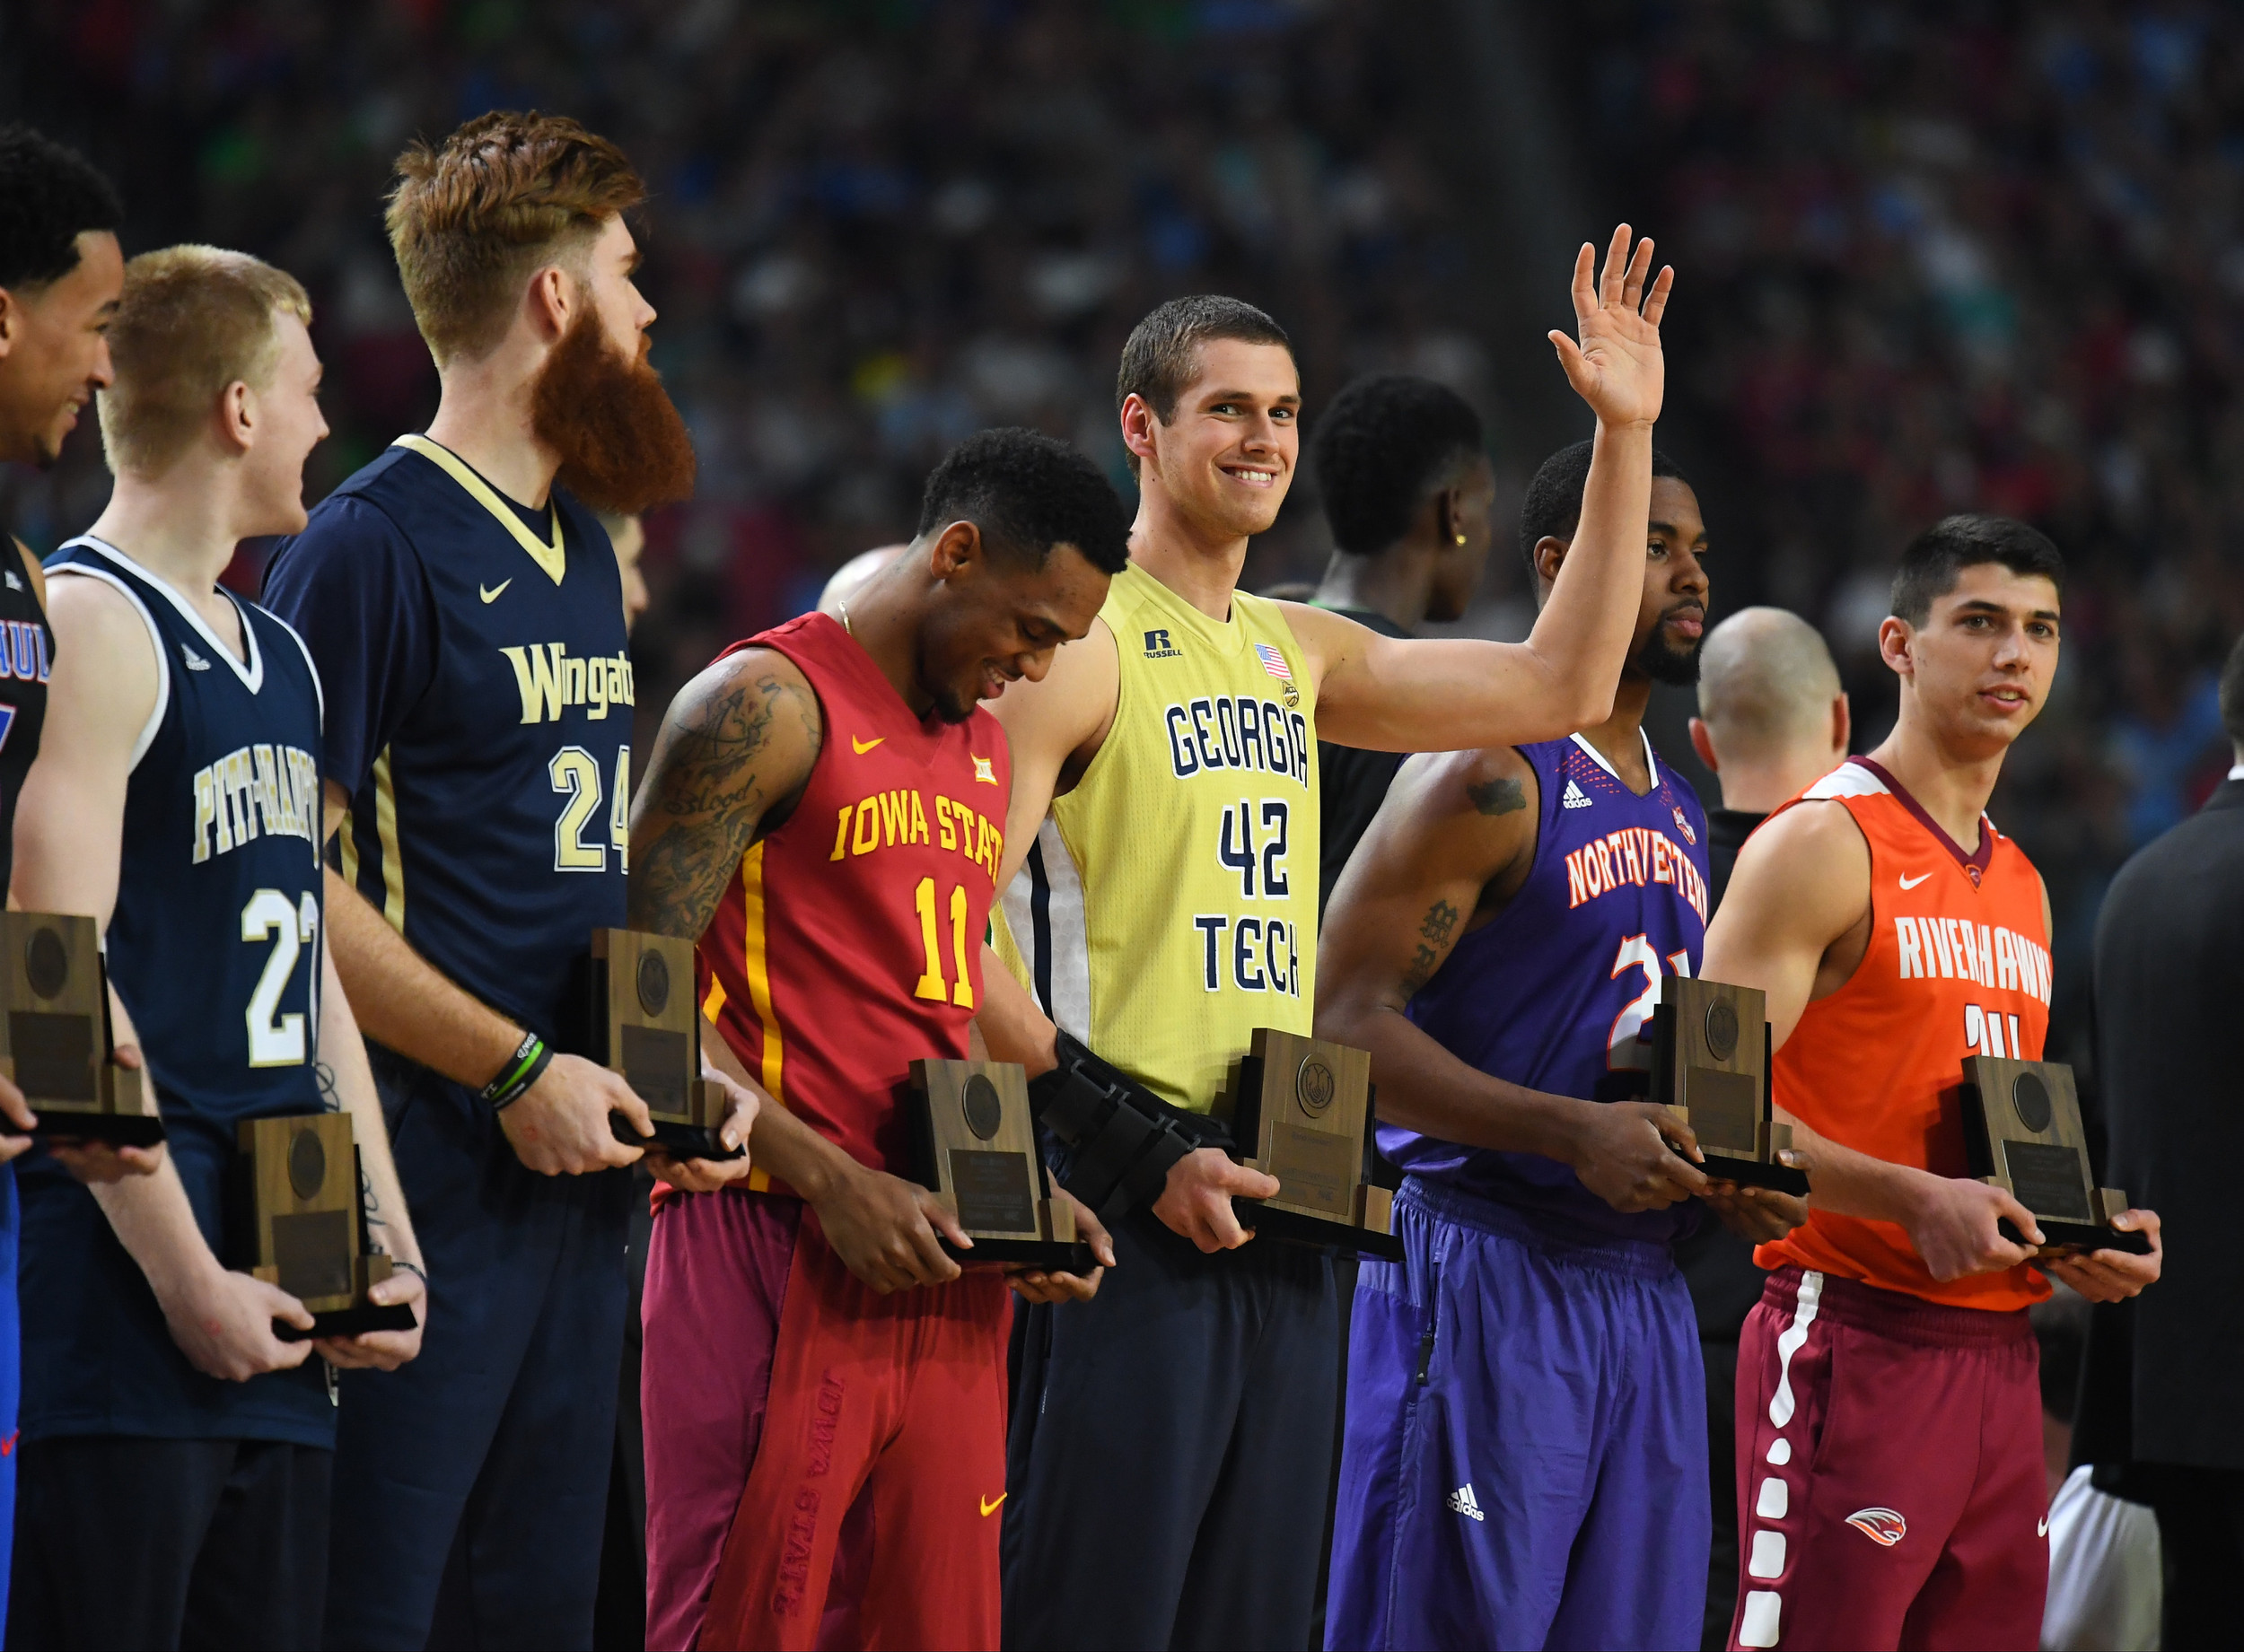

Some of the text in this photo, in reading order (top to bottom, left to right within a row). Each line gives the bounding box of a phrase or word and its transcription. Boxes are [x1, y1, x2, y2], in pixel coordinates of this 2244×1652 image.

[1143, 649, 1183, 659] RUSSELL
[1165, 695, 1308, 791] GEORGIA
[548, 745, 630, 875] 24
[829, 790, 1004, 888] IOWA STAT
[1217, 797, 1290, 900] 42
[914, 877, 974, 1010] 11
[1193, 913, 1301, 999] TECH
[1607, 932, 1691, 1072] 2
[1446, 1498, 1485, 1522] adidas
